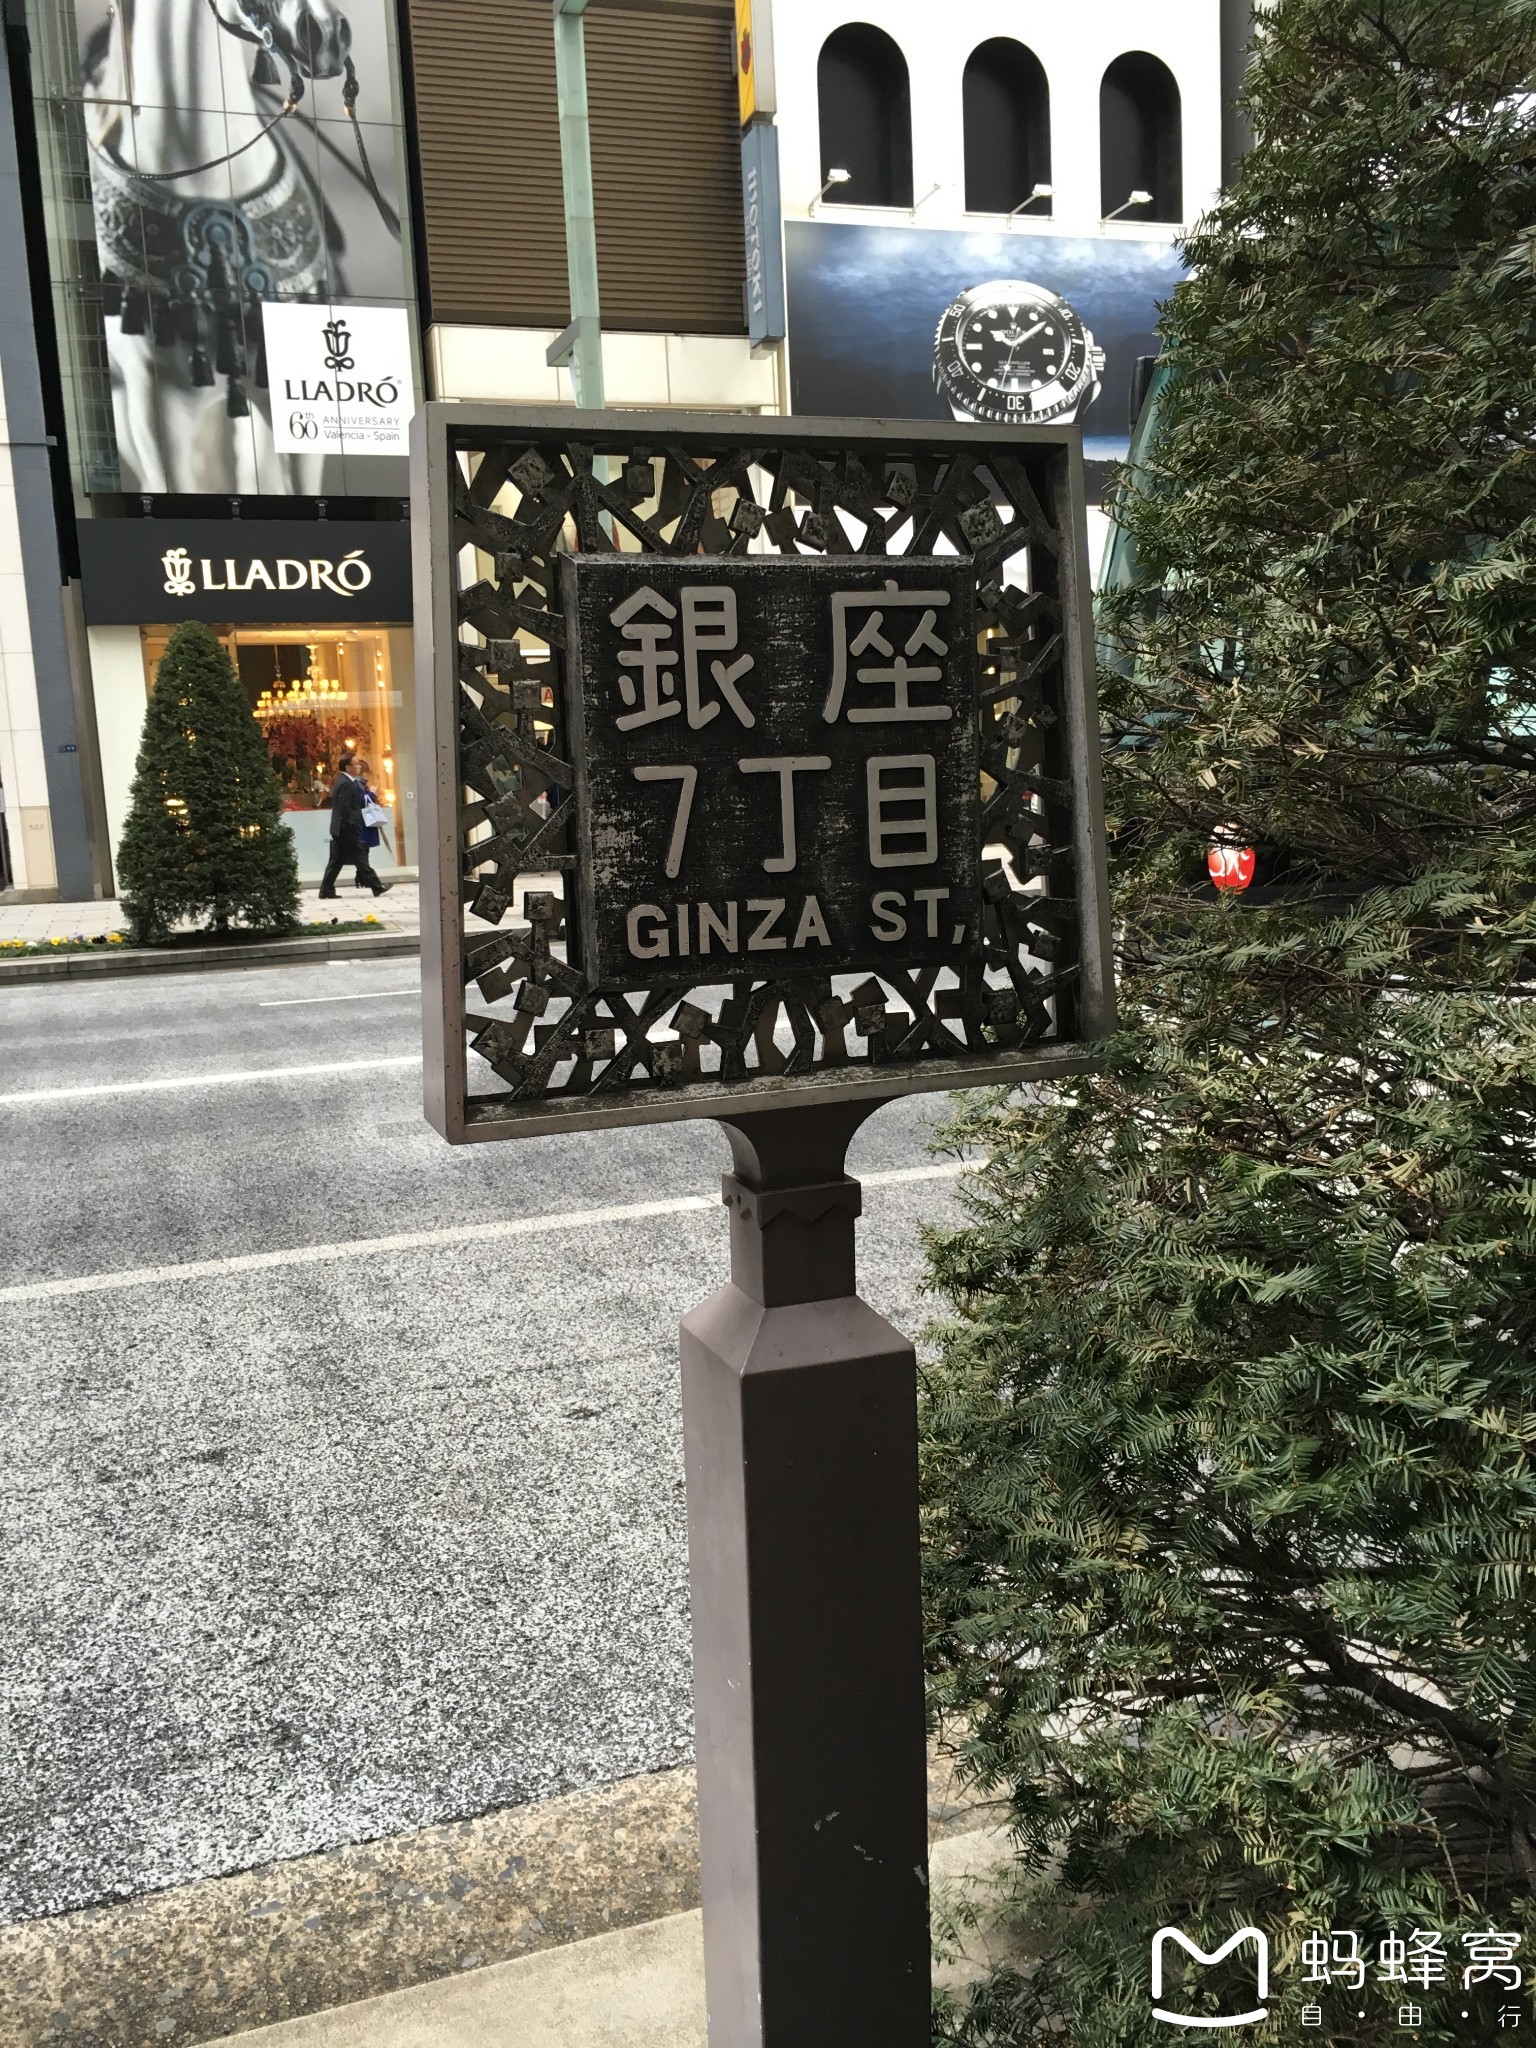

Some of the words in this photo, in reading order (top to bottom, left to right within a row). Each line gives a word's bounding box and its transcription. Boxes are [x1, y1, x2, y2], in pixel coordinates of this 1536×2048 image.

[323, 416, 400, 426] ANNIVERSARY
[1007, 395, 1025, 411] 30
[323, 430, 365, 440] Valencia
[373, 431, 400, 442] Spain
[200, 550, 372, 597] LLADRÓ
[608, 579, 953, 732] 銀座
[632, 754, 940, 879] 7丁目
[626, 895, 831, 959] GINZA
